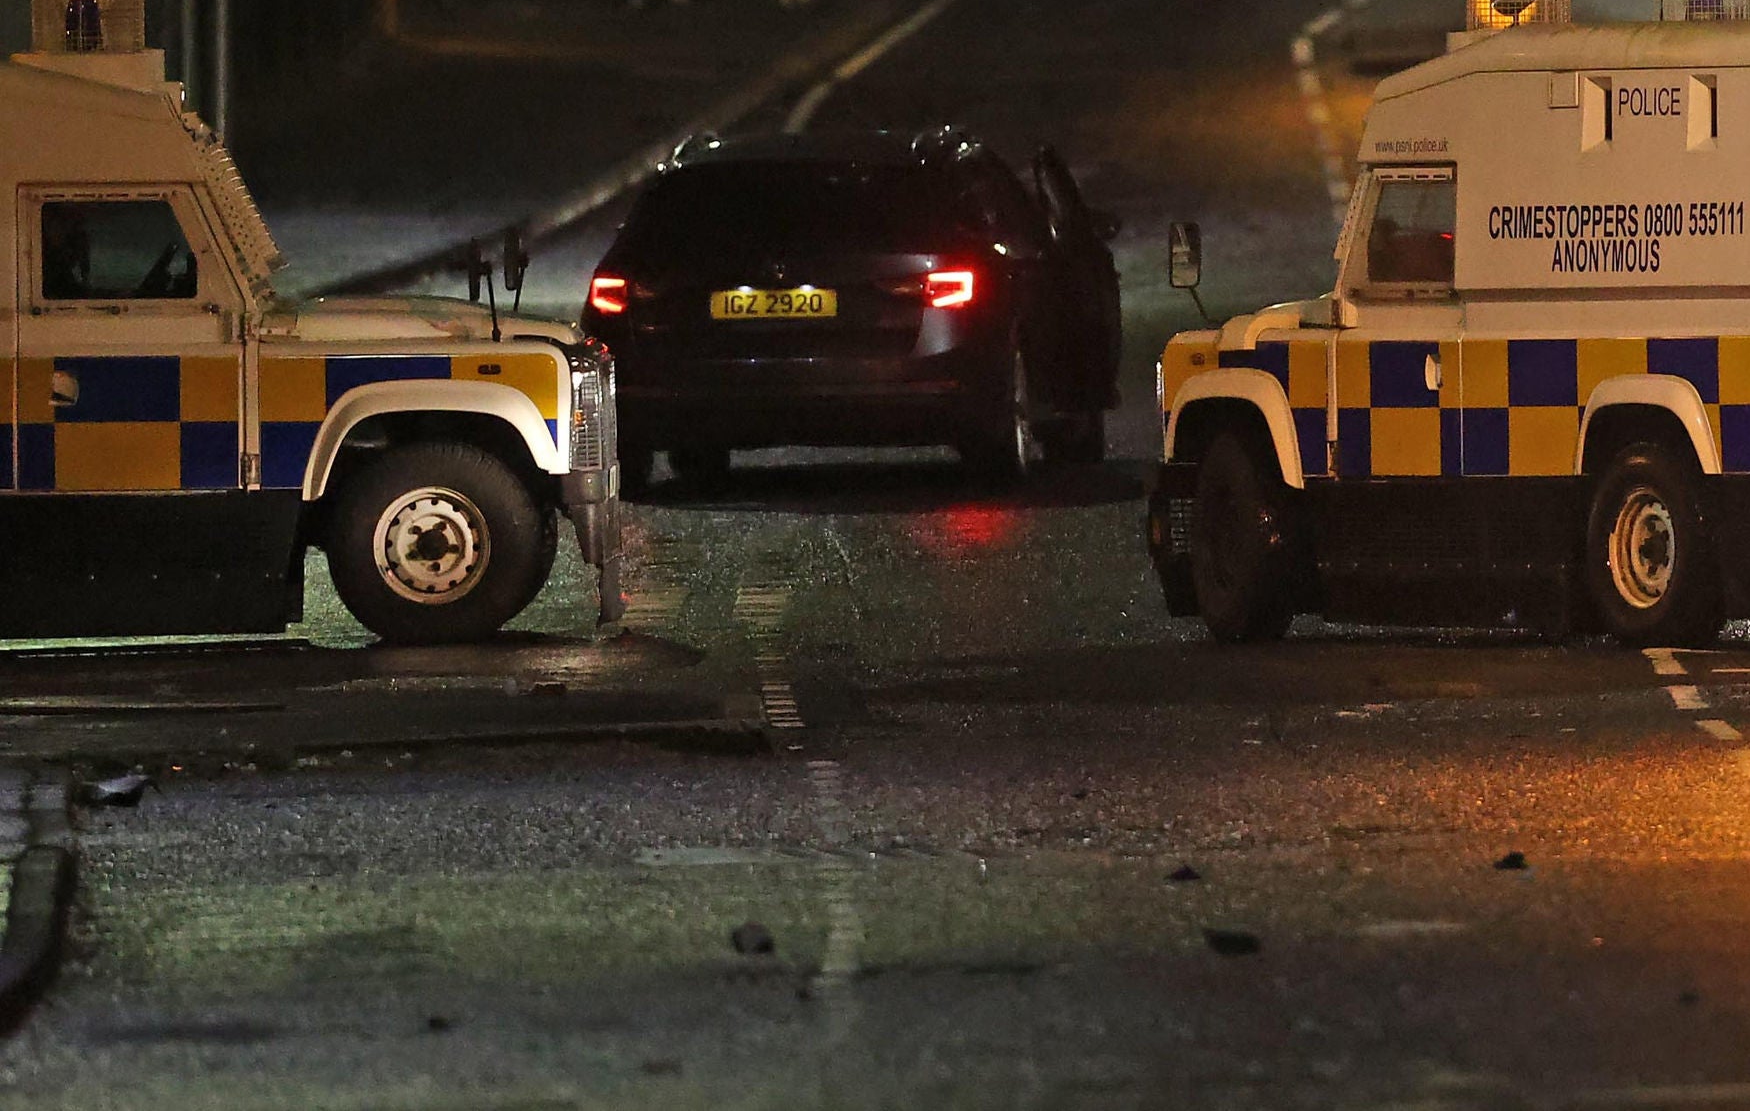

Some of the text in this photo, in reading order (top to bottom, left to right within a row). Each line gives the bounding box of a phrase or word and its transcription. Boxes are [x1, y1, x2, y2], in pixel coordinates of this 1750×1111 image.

[1618, 86, 1682, 117] POLICE
[1488, 201, 1745, 240] CRIMESTOPPERS 0800 555111
[1551, 239, 1661, 273] ANONYMOUS
[724, 294, 823, 315] IGZ 2920
